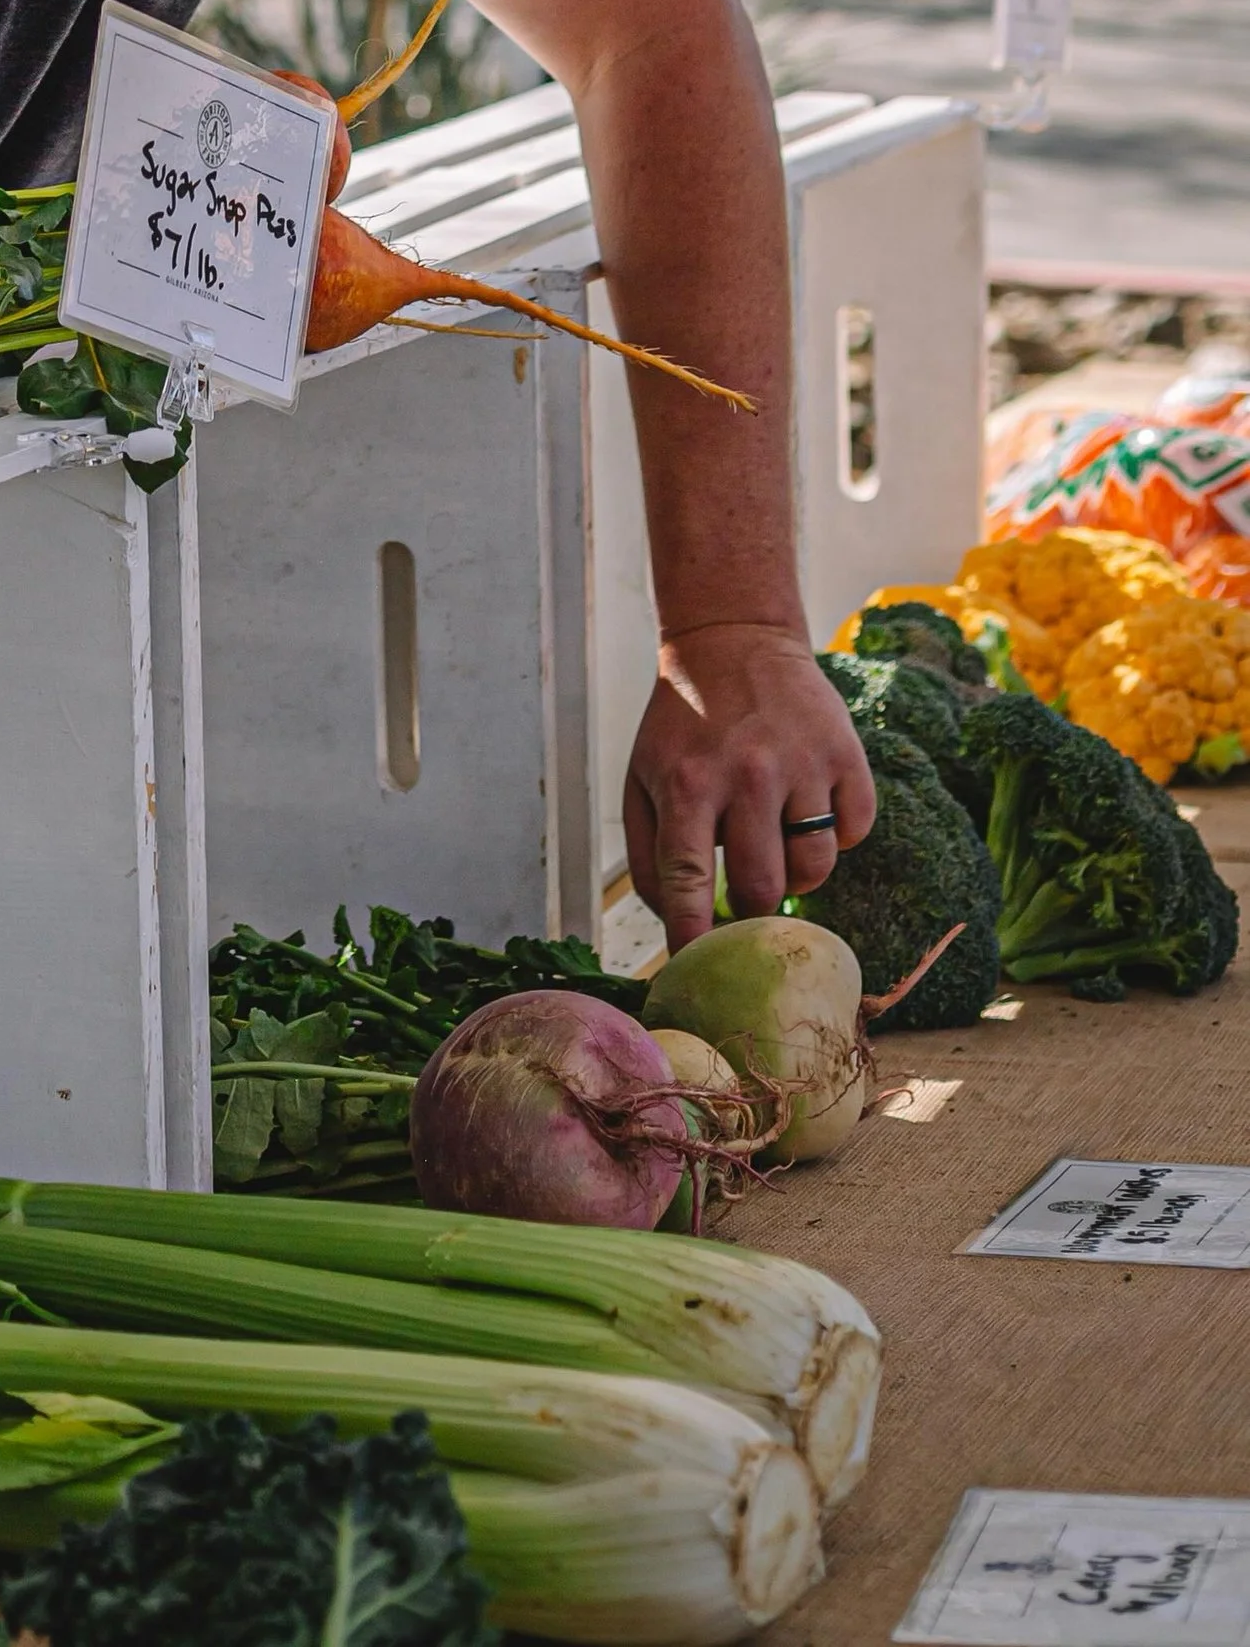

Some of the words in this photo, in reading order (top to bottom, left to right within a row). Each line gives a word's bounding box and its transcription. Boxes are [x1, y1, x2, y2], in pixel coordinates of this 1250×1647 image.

[141, 140, 201, 217] Sugar
[205, 170, 247, 237] Snap
[257, 193, 296, 248] Peas
[148, 211, 224, 290] $7/lb.
[193, 287, 219, 303] ARIZONA
